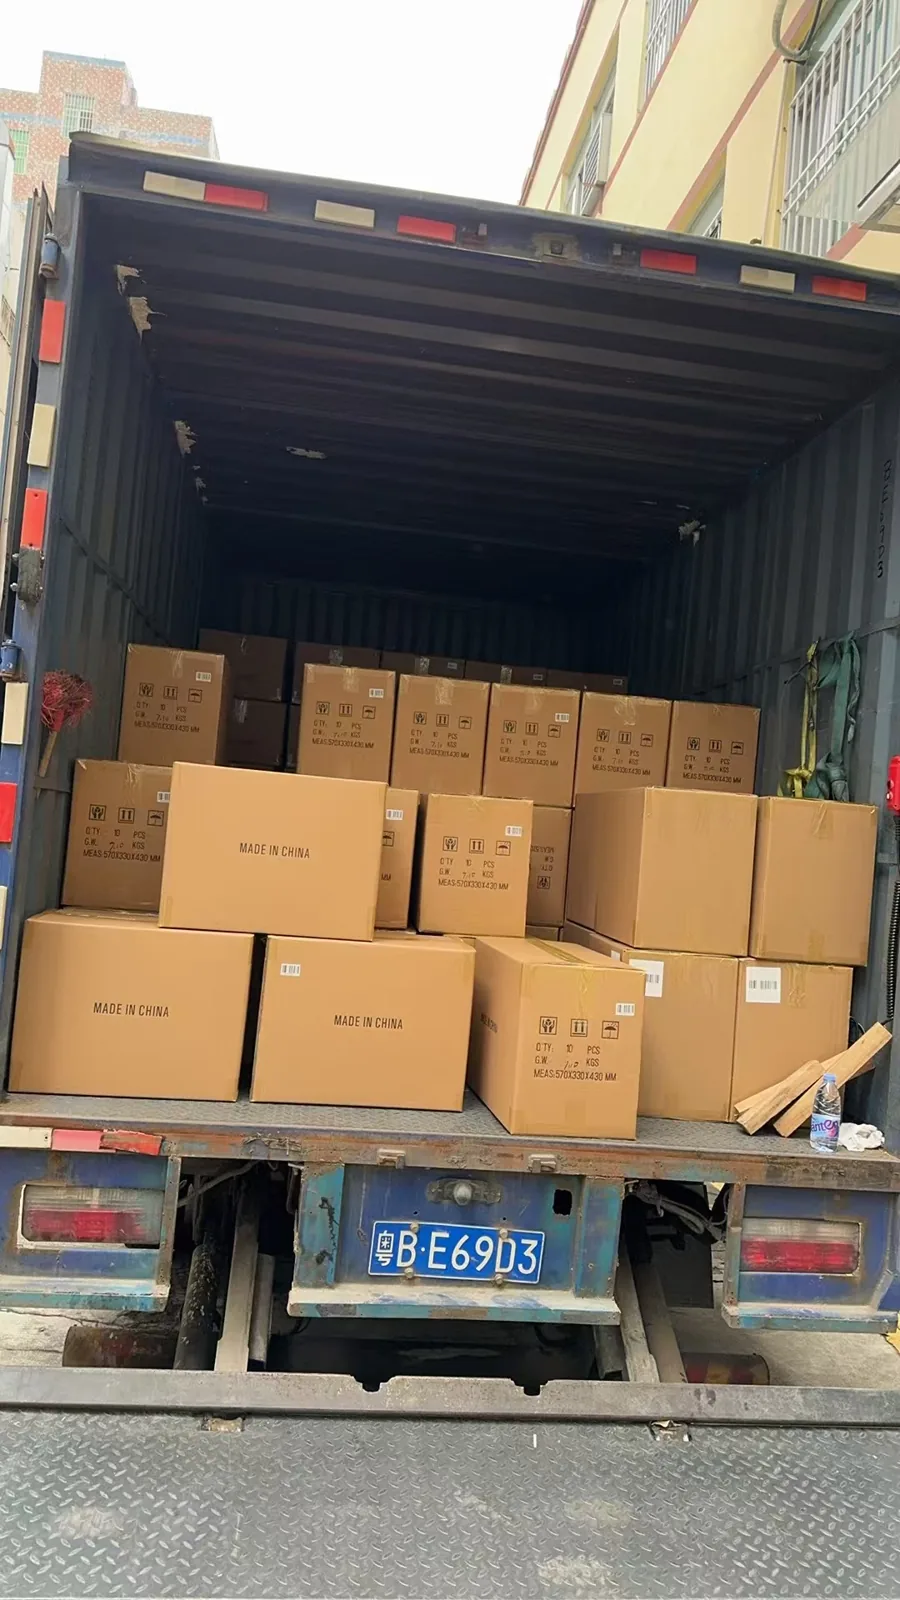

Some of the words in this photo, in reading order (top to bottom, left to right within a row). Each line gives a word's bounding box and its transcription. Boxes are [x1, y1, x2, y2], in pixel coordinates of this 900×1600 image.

[113, 828, 121, 837] 10
[132, 830, 146, 840] PCS
[131, 841, 145, 850] KGS
[239, 842, 267, 855] MADE
[269, 844, 279, 856] IN
[281, 845, 310, 859] CHINA
[149, 854, 161, 862] MM
[466, 859, 472, 867] 10
[483, 860, 495, 869] PCS
[482, 870, 494, 878] KGS
[498, 882, 509, 890] MM
[93, 1002, 123, 1015] MADE
[125, 1004, 136, 1016] IN
[138, 1004, 169, 1018] CHINA
[333, 1014, 361, 1027] MADE
[362, 1016, 373, 1028] IN
[375, 1017, 403, 1030] CHINA
[566, 1043, 574, 1053] 10
[587, 1045, 601, 1055] PCS
[585, 1058, 600, 1068] KGS
[604, 1072, 617, 1081] MM
